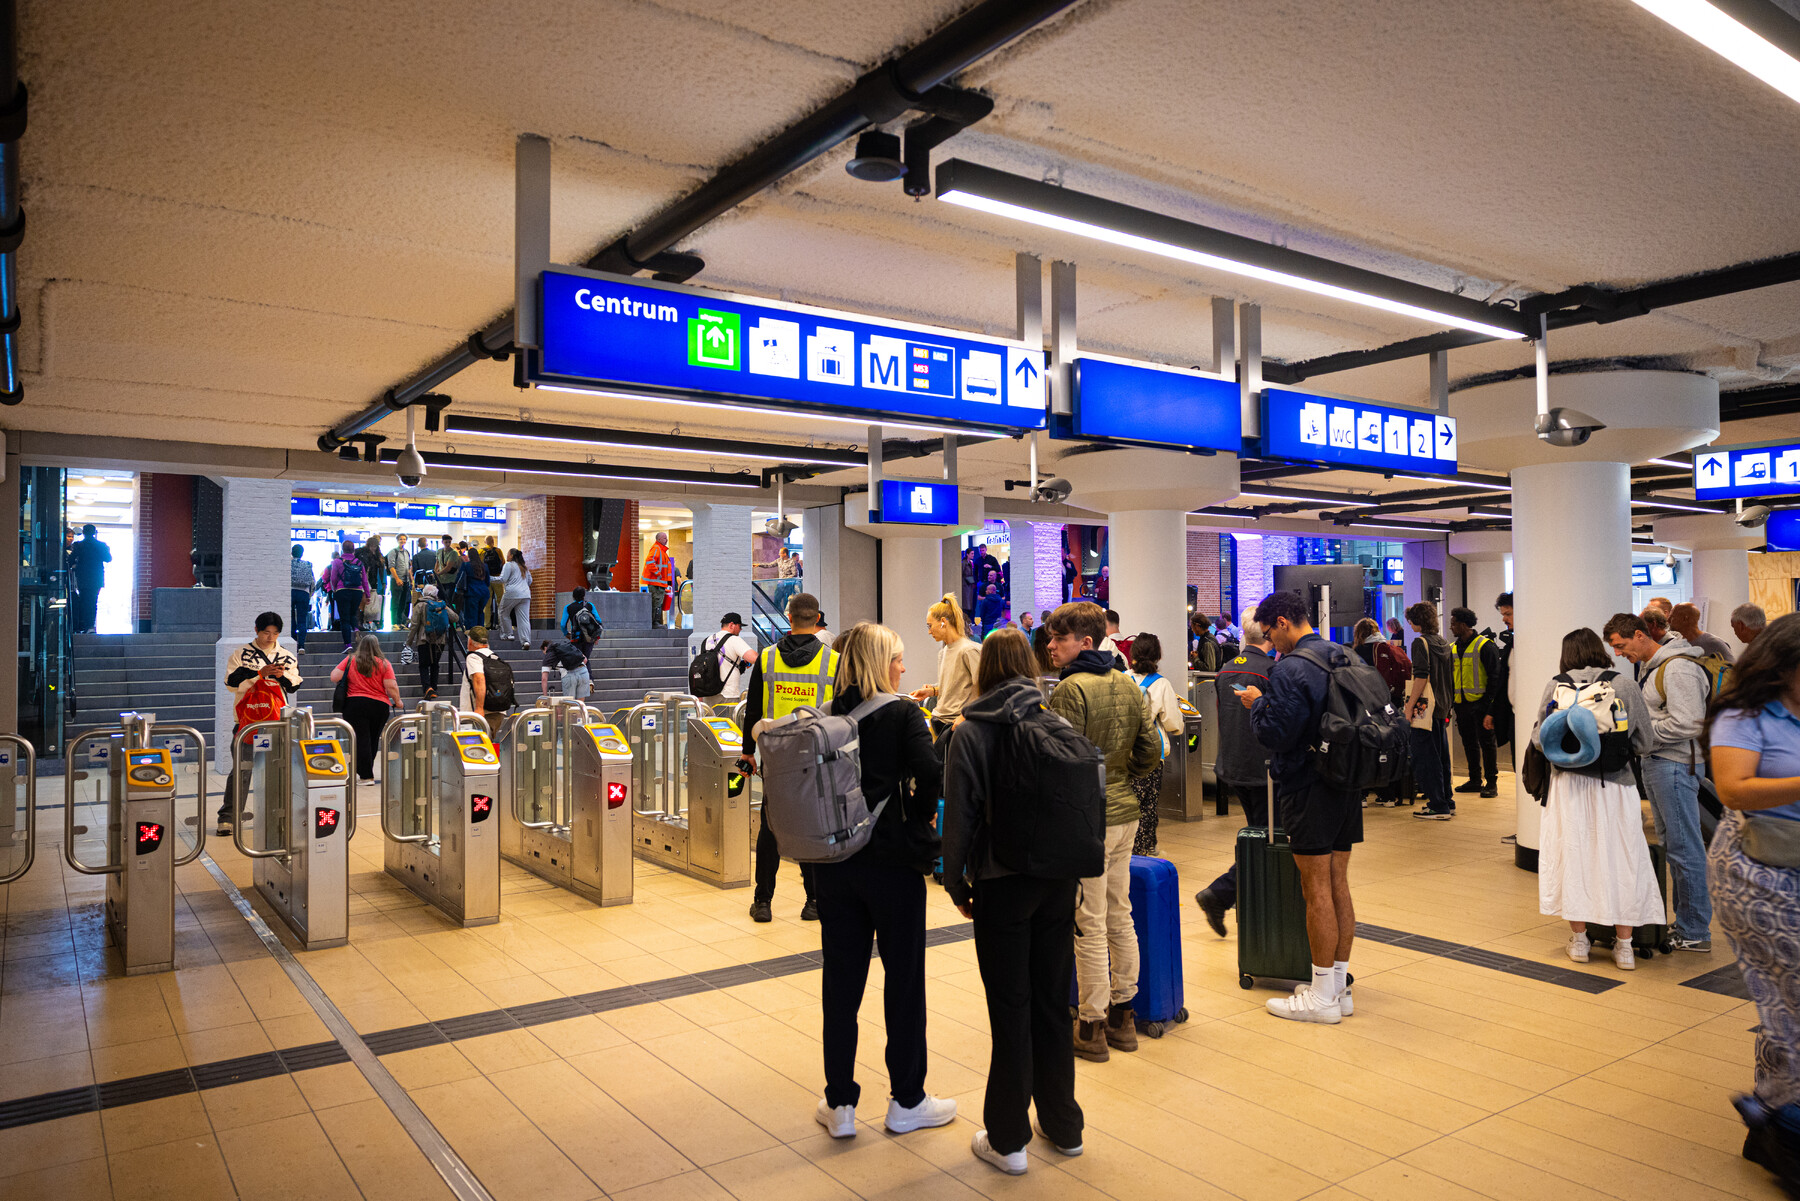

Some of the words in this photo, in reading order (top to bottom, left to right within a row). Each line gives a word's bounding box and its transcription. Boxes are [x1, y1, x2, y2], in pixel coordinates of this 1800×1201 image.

[575, 288, 678, 323] Centrum
[913, 348, 928, 358] M51
[869, 352, 899, 387] M
[913, 364, 928, 373] M53
[914, 379, 929, 388] M54
[1333, 428, 1352, 444] WC
[1393, 430, 1398, 449] 1
[1418, 433, 1426, 453] 2
[1789, 461, 1797, 477] 1
[775, 684, 815, 697] ProRail
